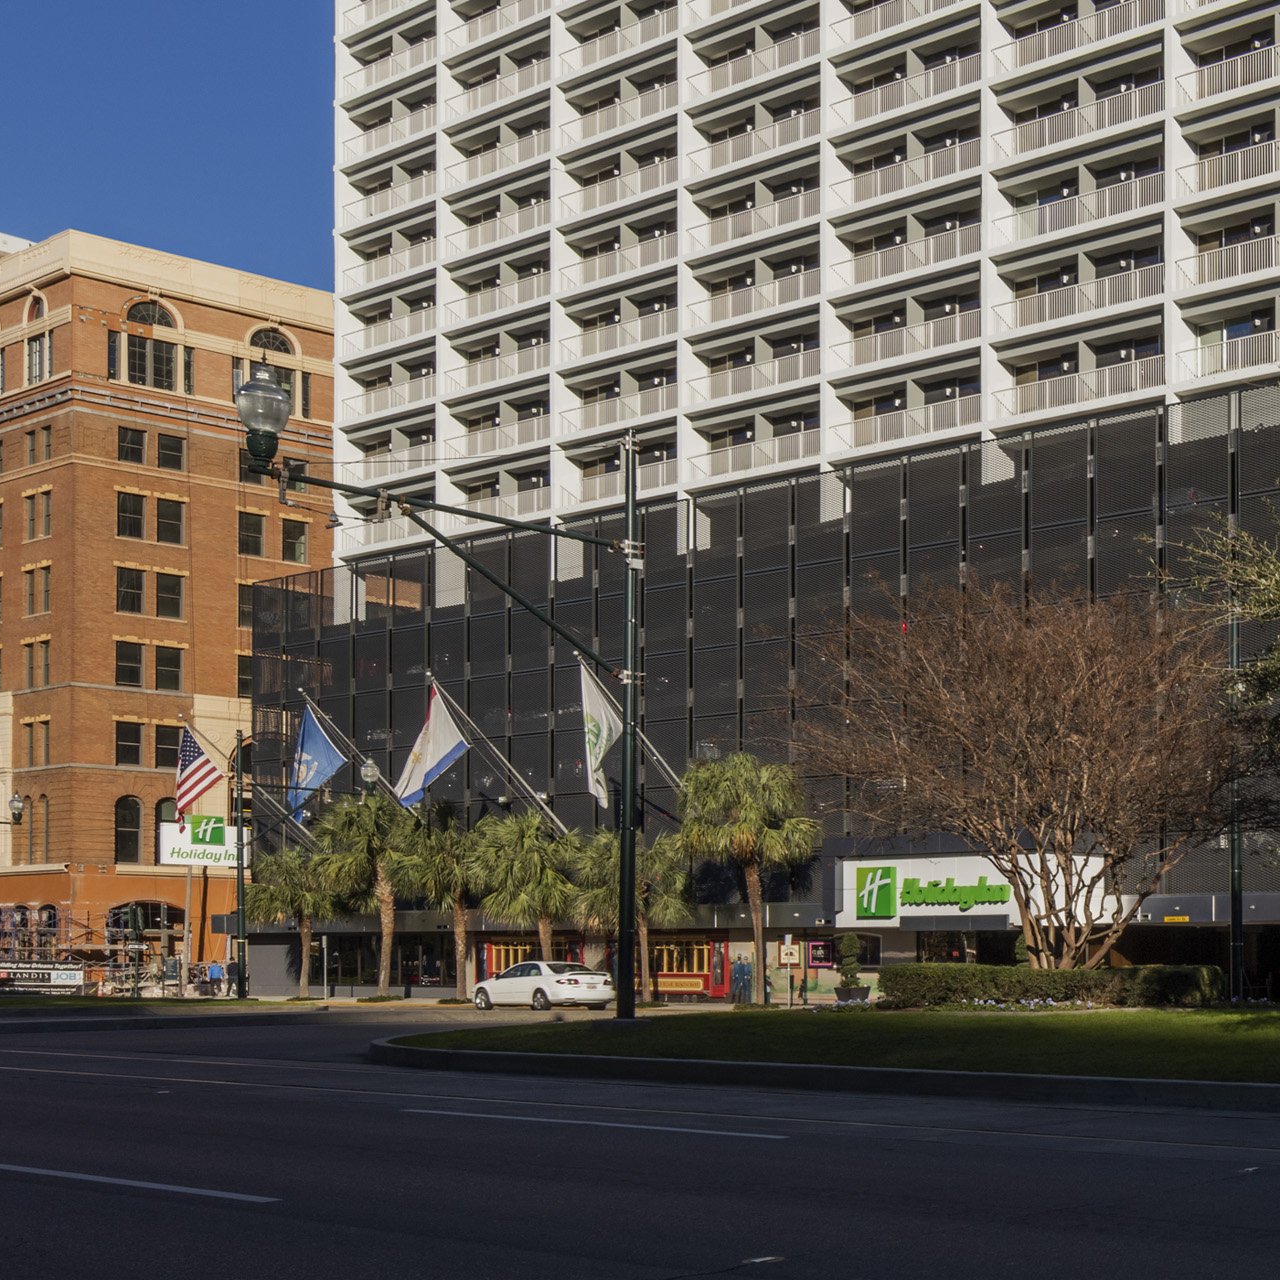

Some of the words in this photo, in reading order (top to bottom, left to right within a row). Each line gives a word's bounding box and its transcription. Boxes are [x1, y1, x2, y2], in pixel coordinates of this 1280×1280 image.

[170, 847, 222, 863] Holiday
[899, 877, 975, 912] Holiday
[974, 876, 1012, 906] Inn
